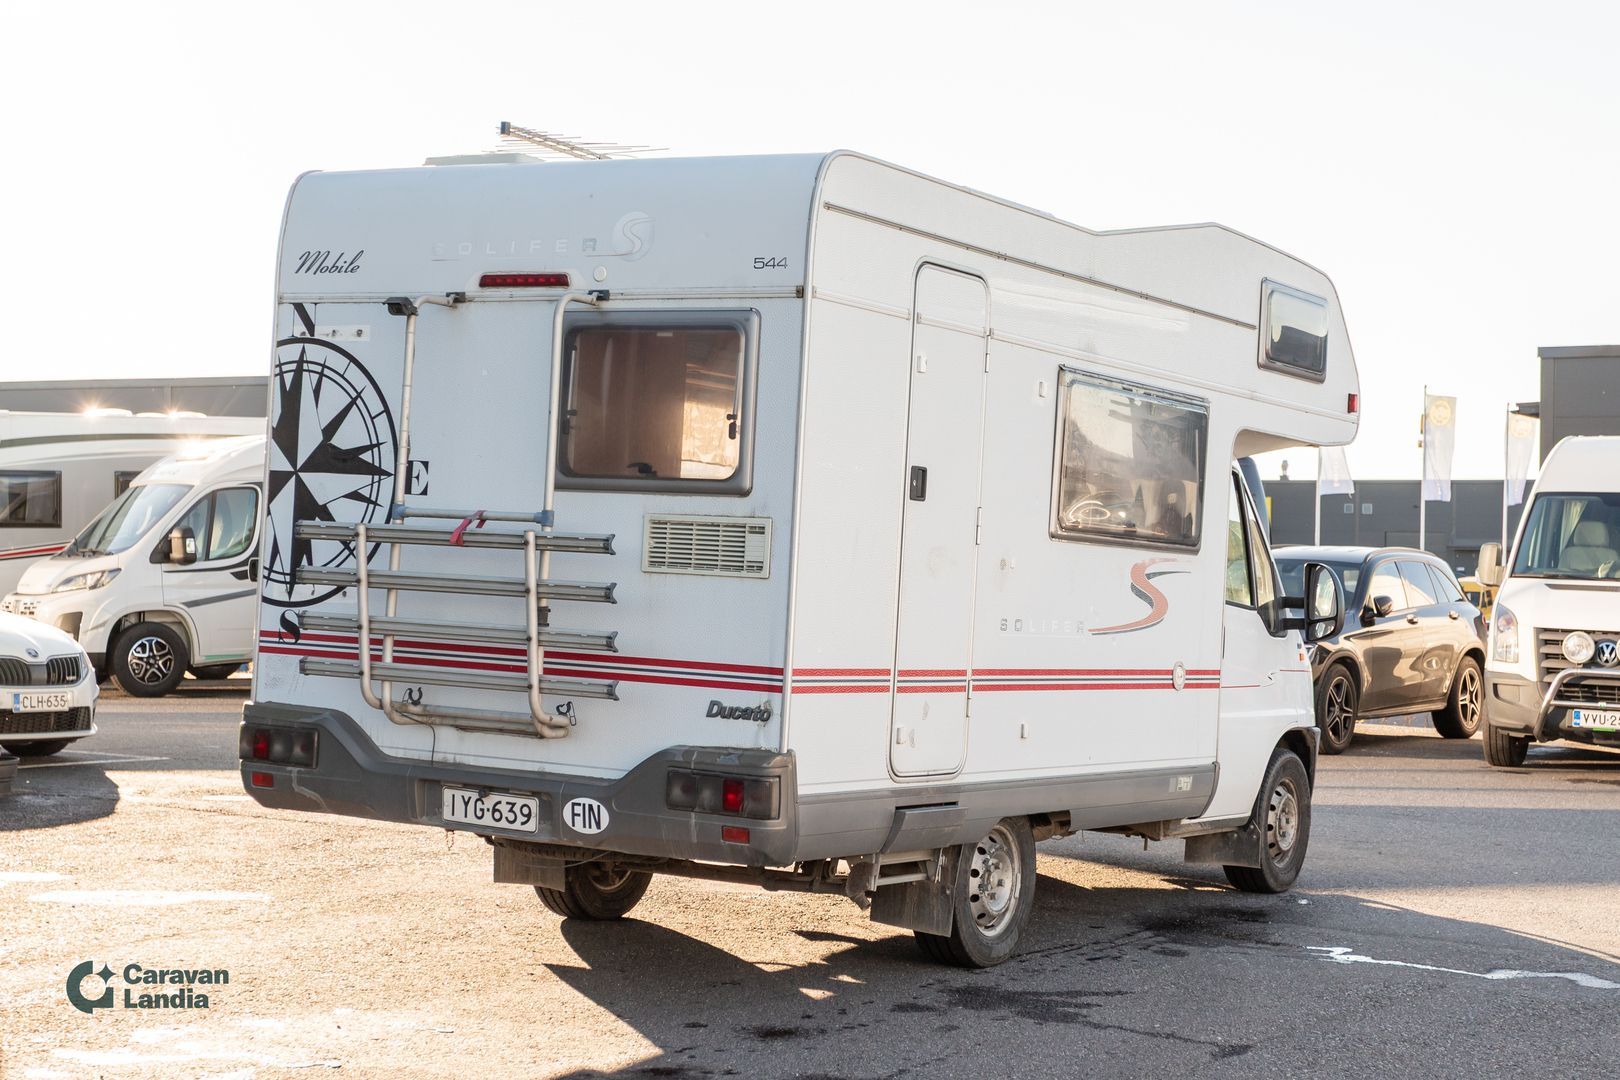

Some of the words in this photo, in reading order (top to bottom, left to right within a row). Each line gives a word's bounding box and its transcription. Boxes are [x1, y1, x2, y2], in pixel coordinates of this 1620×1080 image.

[295, 249, 364, 275] Mobile
[753, 256, 788, 269] 544
[403, 459, 430, 496] E
[706, 699, 772, 722] Ducato
[571, 802, 602, 830] FIN
